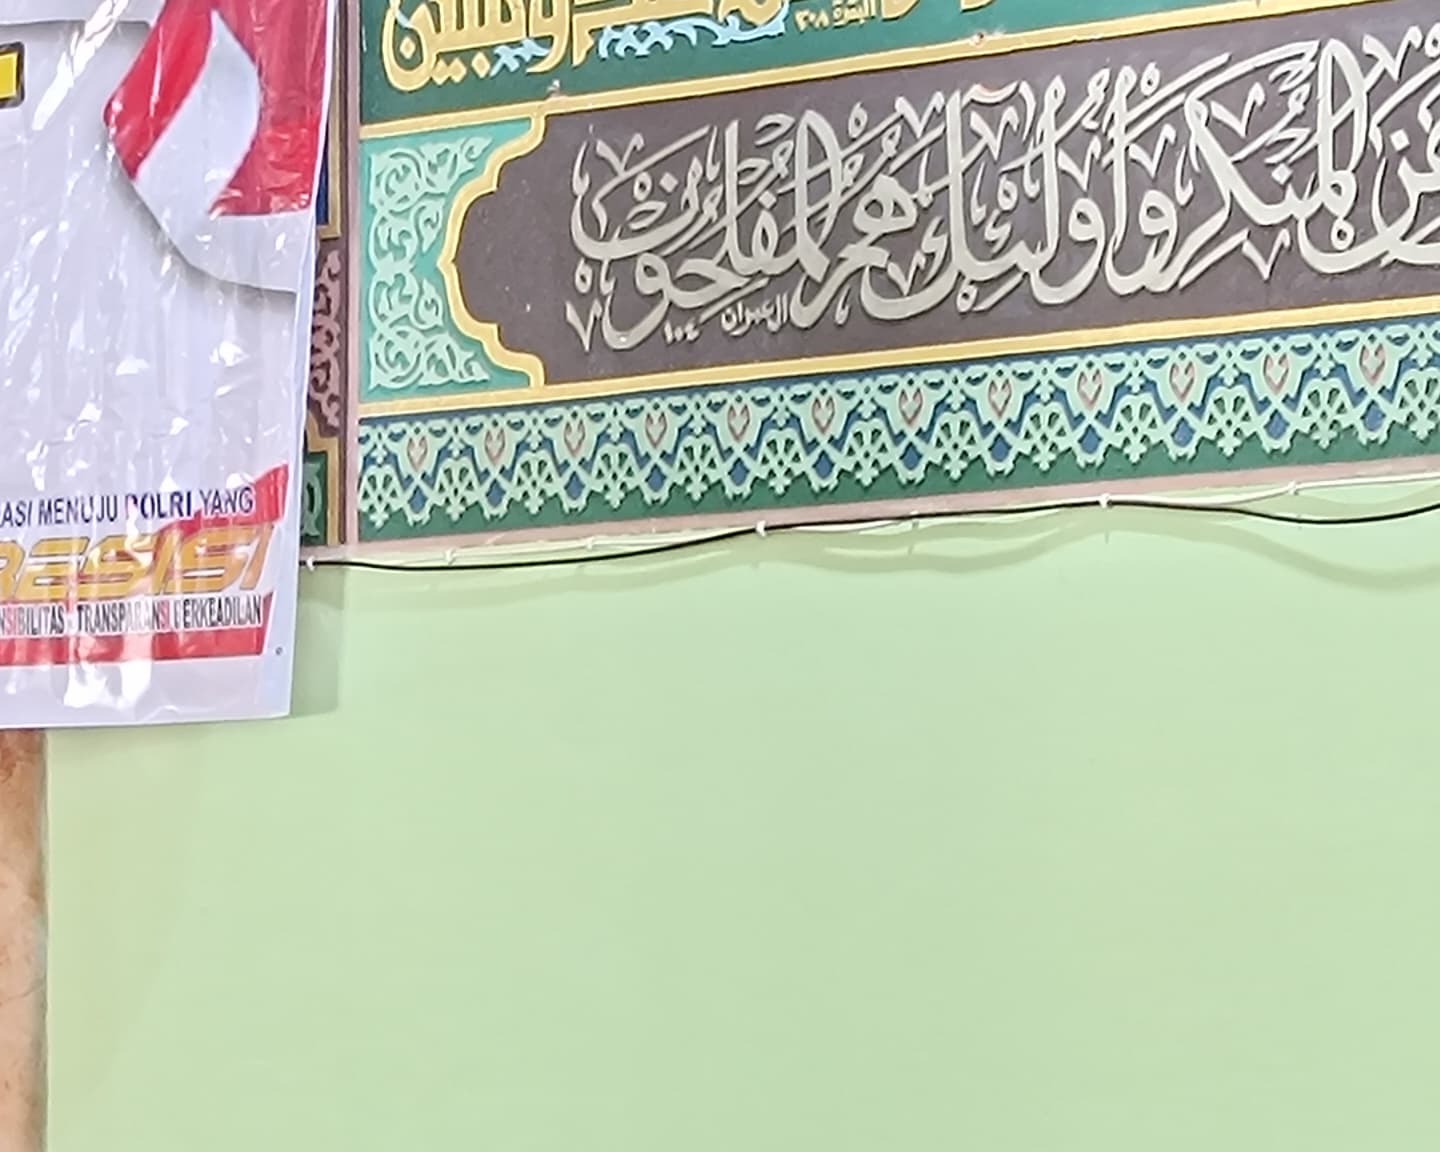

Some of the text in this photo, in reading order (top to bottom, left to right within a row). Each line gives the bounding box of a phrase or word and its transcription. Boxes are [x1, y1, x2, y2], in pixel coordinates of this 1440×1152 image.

[37, 494, 119, 527] MENUJU
[125, 490, 192, 522] POLRI
[199, 486, 254, 517] YANG
